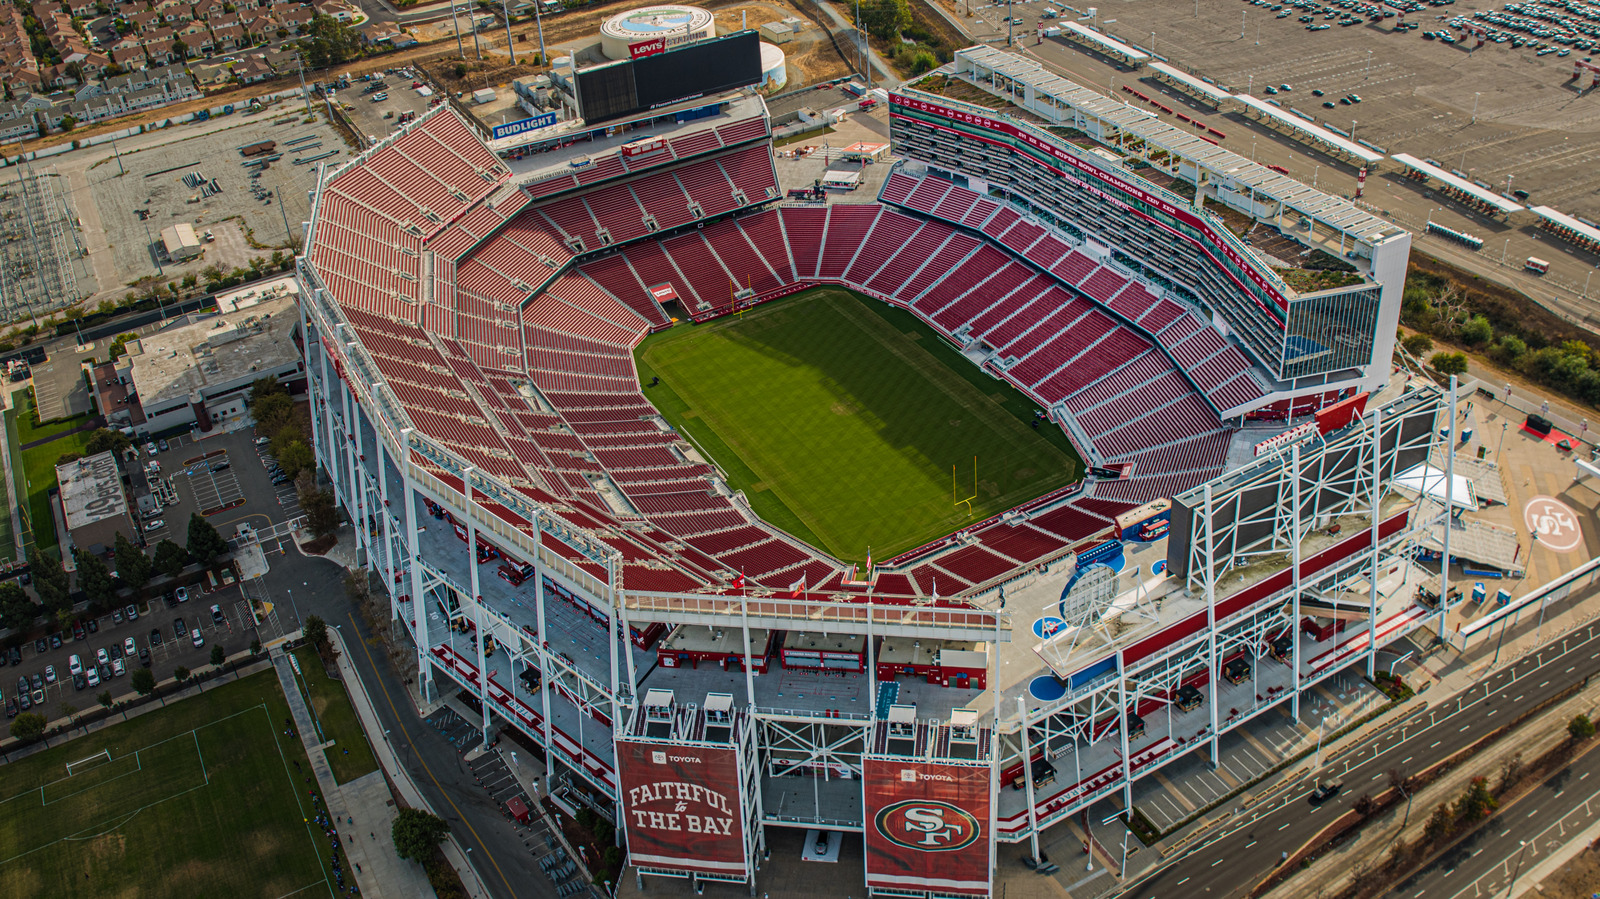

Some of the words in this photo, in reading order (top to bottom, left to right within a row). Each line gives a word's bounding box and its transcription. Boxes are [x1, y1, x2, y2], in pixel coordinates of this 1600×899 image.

[1054, 150, 1077, 164] SUPER
[1078, 159, 1098, 176] BOWL
[1099, 170, 1143, 198] CHAMPIONS
[430, 612, 438, 620] 10
[668, 756, 702, 764] TOYOTA
[919, 774, 952, 782] TOYOTA
[630, 782, 732, 816] FAITHFUL
[674, 800, 688, 812] to
[632, 810, 682, 831] THE
[686, 814, 734, 836] BAY
[904, 808, 962, 845] SF
